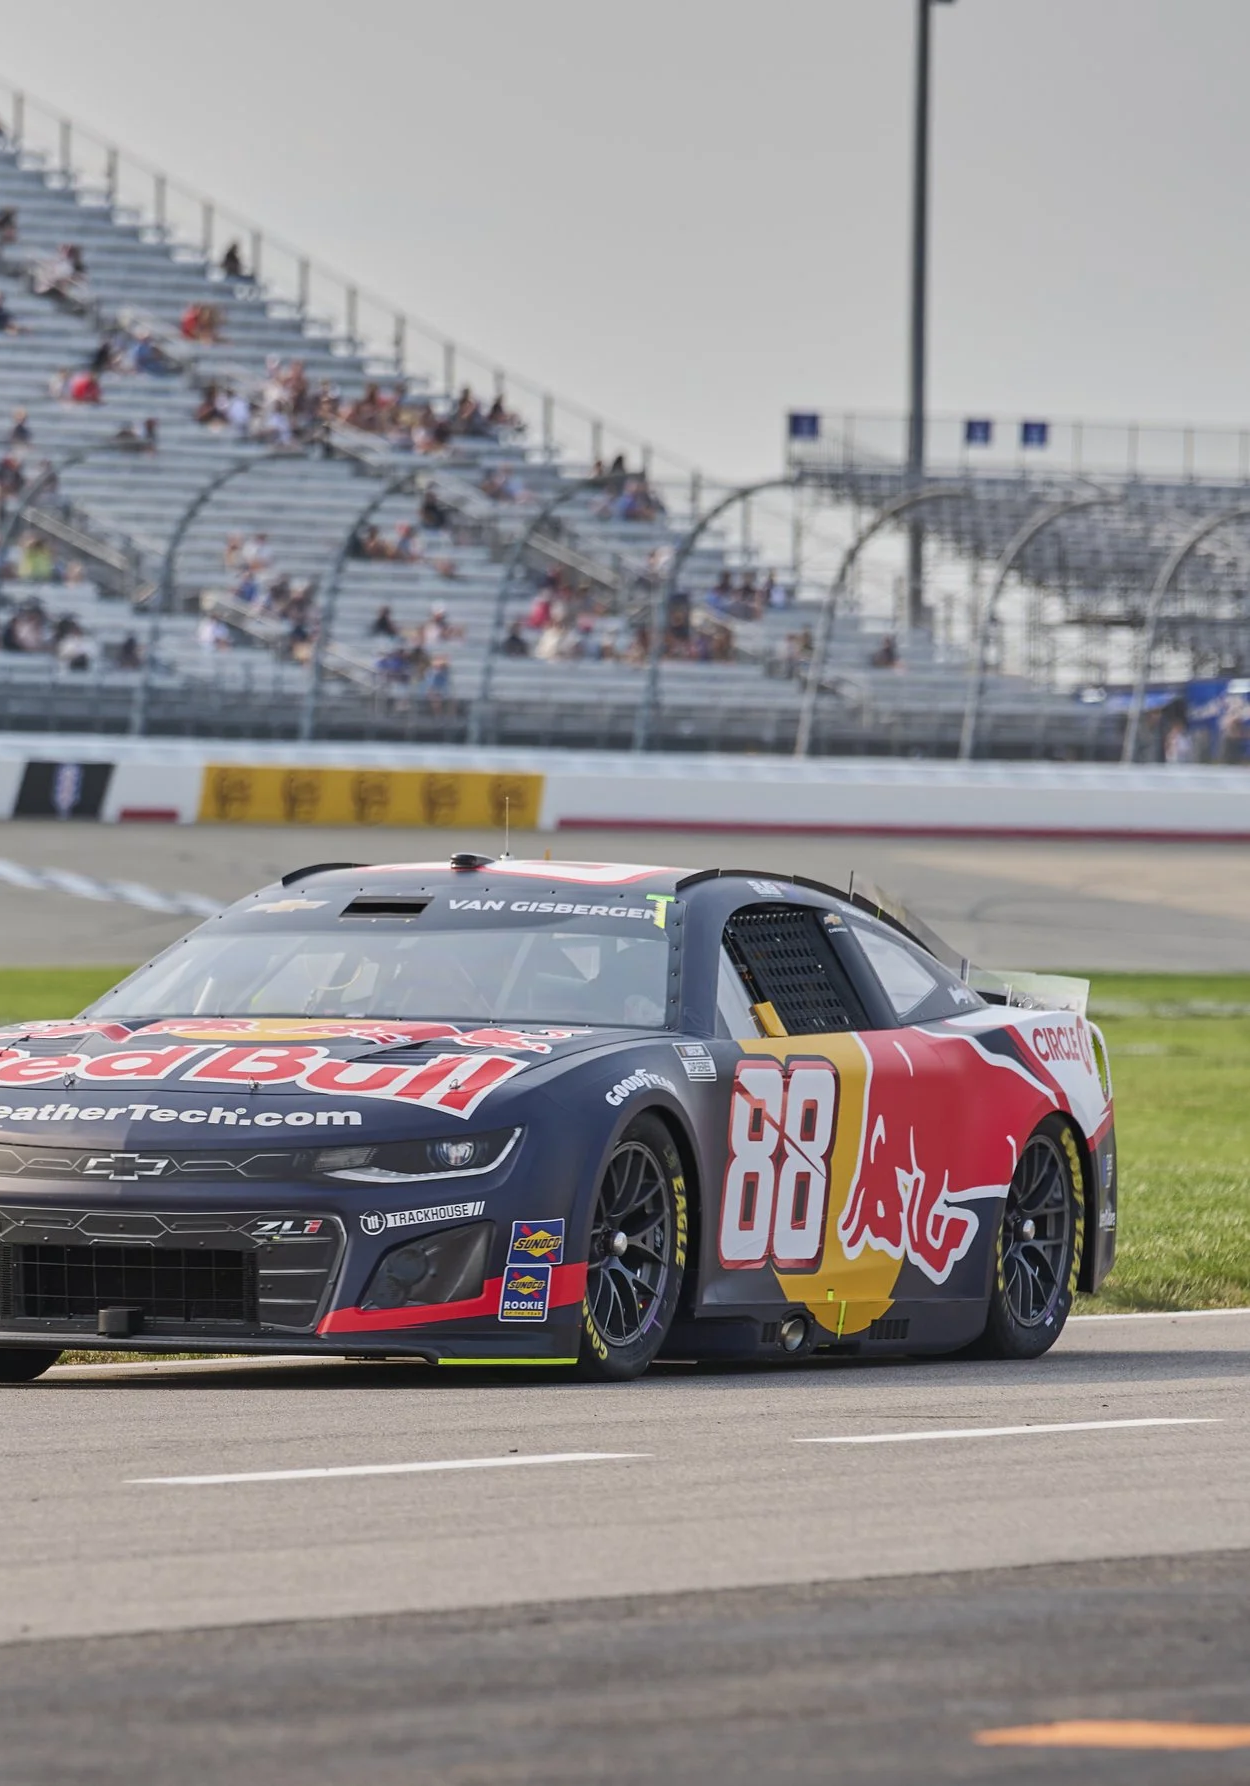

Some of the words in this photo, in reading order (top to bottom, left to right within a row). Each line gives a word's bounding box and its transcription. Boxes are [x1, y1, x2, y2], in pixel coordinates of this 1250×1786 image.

[449, 900, 504, 911] VAN
[1033, 1026, 1080, 1062] CIRCLE
[188, 1046, 520, 1114] Bull
[719, 1060, 839, 1270] 88
[390, 1203, 469, 1226] TRACKHOUSE
[671, 1174, 688, 1271] EAGLE
[251, 1219, 323, 1235] ZL1
[515, 1237, 560, 1249] SUNOCO
[508, 1281, 544, 1289] SUNOCO
[503, 1301, 544, 1310] ROOKIE
